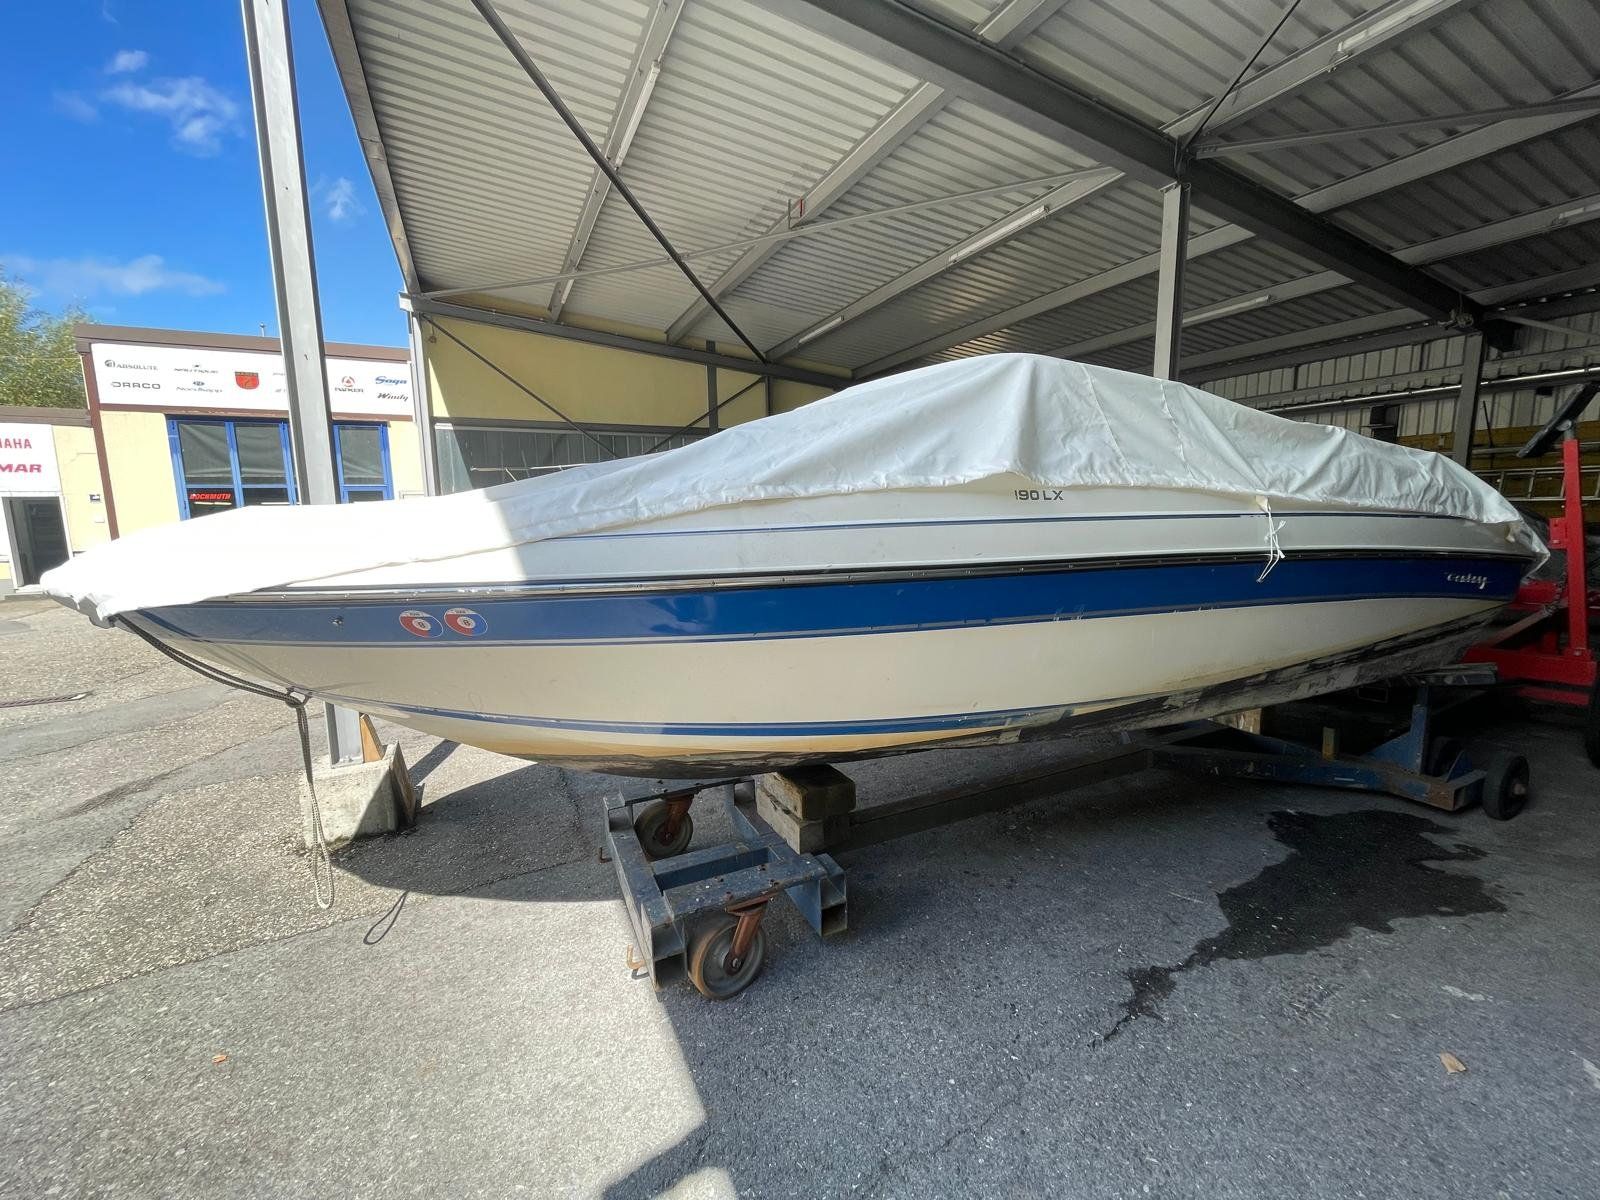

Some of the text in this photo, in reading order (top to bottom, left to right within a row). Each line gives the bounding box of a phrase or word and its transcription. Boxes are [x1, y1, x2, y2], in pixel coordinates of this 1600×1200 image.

[111, 381, 161, 390] DRACO
[377, 392, 409, 402] Windy
[0, 438, 32, 449] AHA
[1014, 489, 1064, 501] 190 LX
